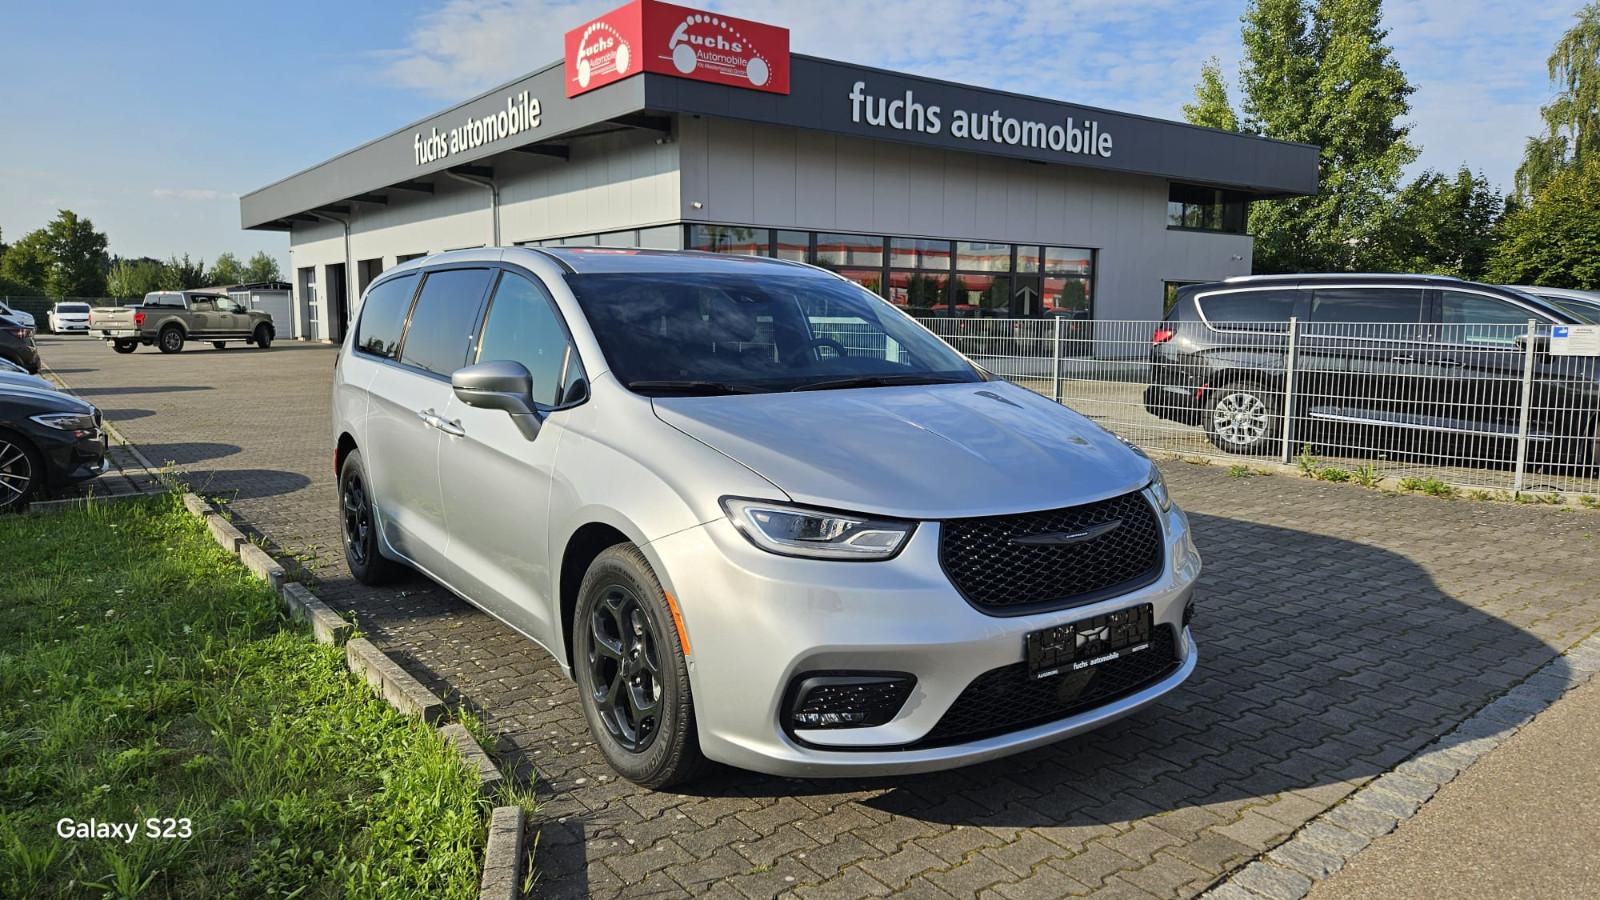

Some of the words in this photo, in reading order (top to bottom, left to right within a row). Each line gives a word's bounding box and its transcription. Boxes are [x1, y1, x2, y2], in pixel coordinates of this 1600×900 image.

[697, 49, 747, 66] Automobile
[414, 127, 448, 165] fuchs
[450, 90, 541, 154] automobile
[849, 81, 941, 134] fuchs
[951, 110, 1113, 158] automobile
[1073, 661, 1089, 671] fuchs
